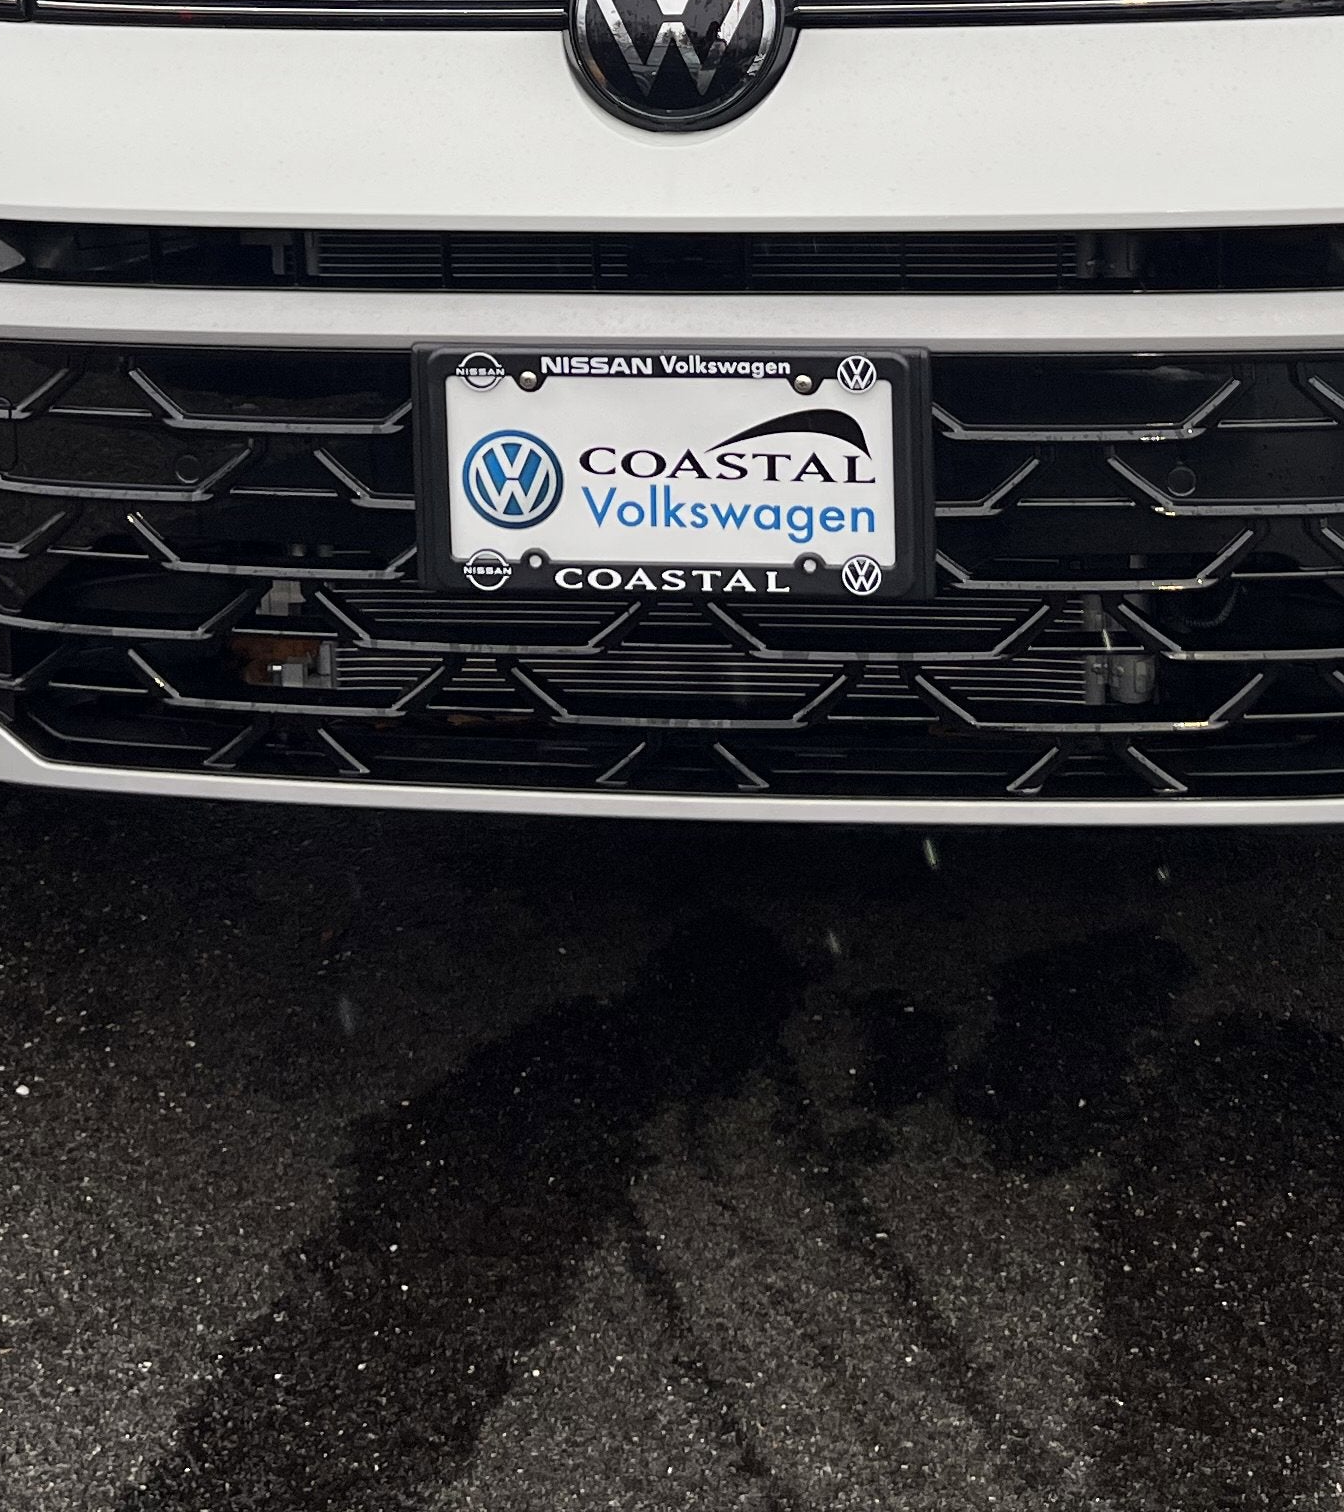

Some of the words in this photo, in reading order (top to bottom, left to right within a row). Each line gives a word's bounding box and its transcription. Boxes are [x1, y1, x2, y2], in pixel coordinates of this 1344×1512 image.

[456, 366, 505, 377] NISSAN
[541, 356, 652, 375] NISSAN
[659, 354, 791, 379] Volkswagen
[838, 356, 876, 393] VW
[467, 434, 559, 525] VW
[579, 447, 876, 484] COASTAL
[581, 484, 876, 544] Volkswagen
[463, 565, 512, 576] NISSAN
[555, 567, 790, 593] COASTAL
[843, 556, 881, 594] VW
